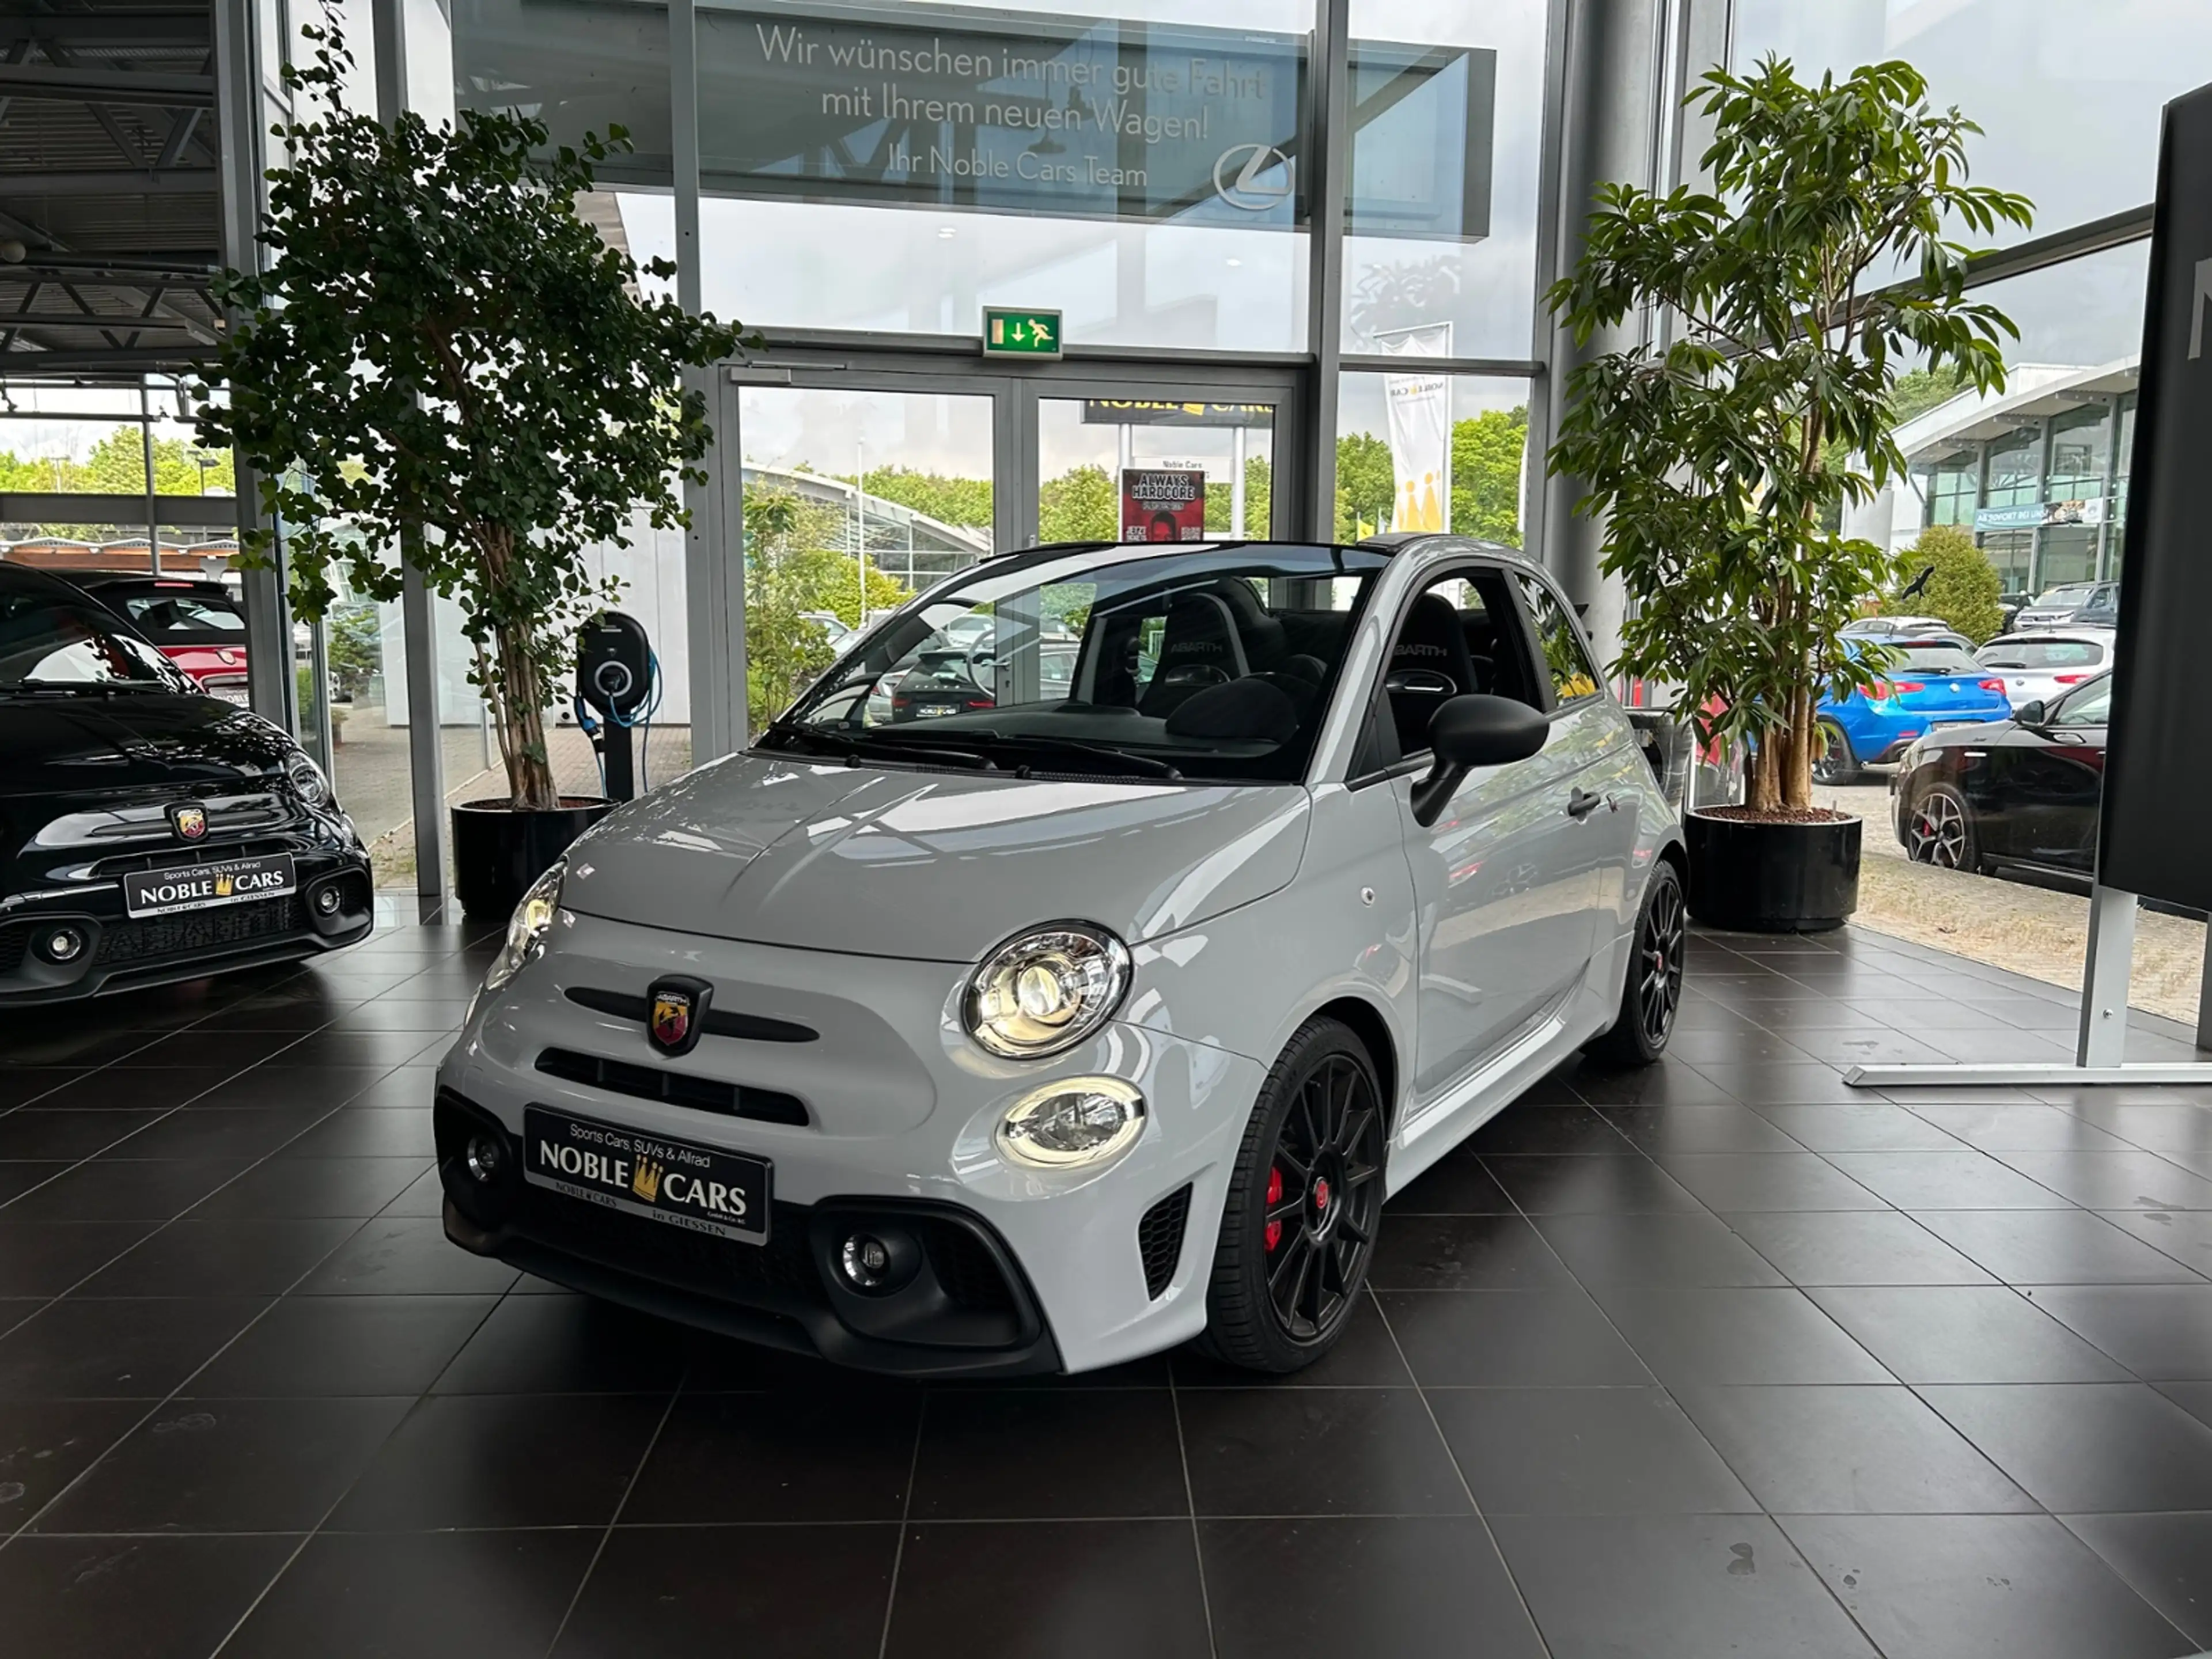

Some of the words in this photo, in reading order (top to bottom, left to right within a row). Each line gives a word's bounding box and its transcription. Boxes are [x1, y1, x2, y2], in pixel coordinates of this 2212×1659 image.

[756, 23, 819, 65] Wir
[828, 37, 993, 77] wünschen
[1003, 48, 1103, 85] immer
[1112, 62, 1179, 97] gute
[1190, 58, 1266, 100] Fahrt
[823, 86, 872, 118] mit
[883, 82, 974, 124] Ihrem
[986, 104, 1081, 131] neuen
[1092, 97, 1208, 144] Wagen!
[888, 143, 922, 173] Ihr
[931, 145, 1009, 178] Noble
[1016, 151, 1076, 183] Cars
[1084, 155, 1147, 187] Team
[1185, 460, 1203, 468] Cars
[1132, 486, 1195, 499] HARDCORE
[1394, 643, 1448, 657] BARTH
[141, 880, 213, 904] NOBLE
[235, 870, 285, 891] CARS
[164, 870, 191, 880] Sports
[570, 1124, 603, 1145] Sports
[634, 1139, 664, 1159] SUVs
[666, 1148, 675, 1161] &
[677, 1152, 711, 1168] Allrad
[540, 1139, 628, 1188] NOBLE
[663, 1173, 747, 1215] CARS
[652, 1210, 664, 1220] in
[668, 1215, 726, 1236] GIESSEN
